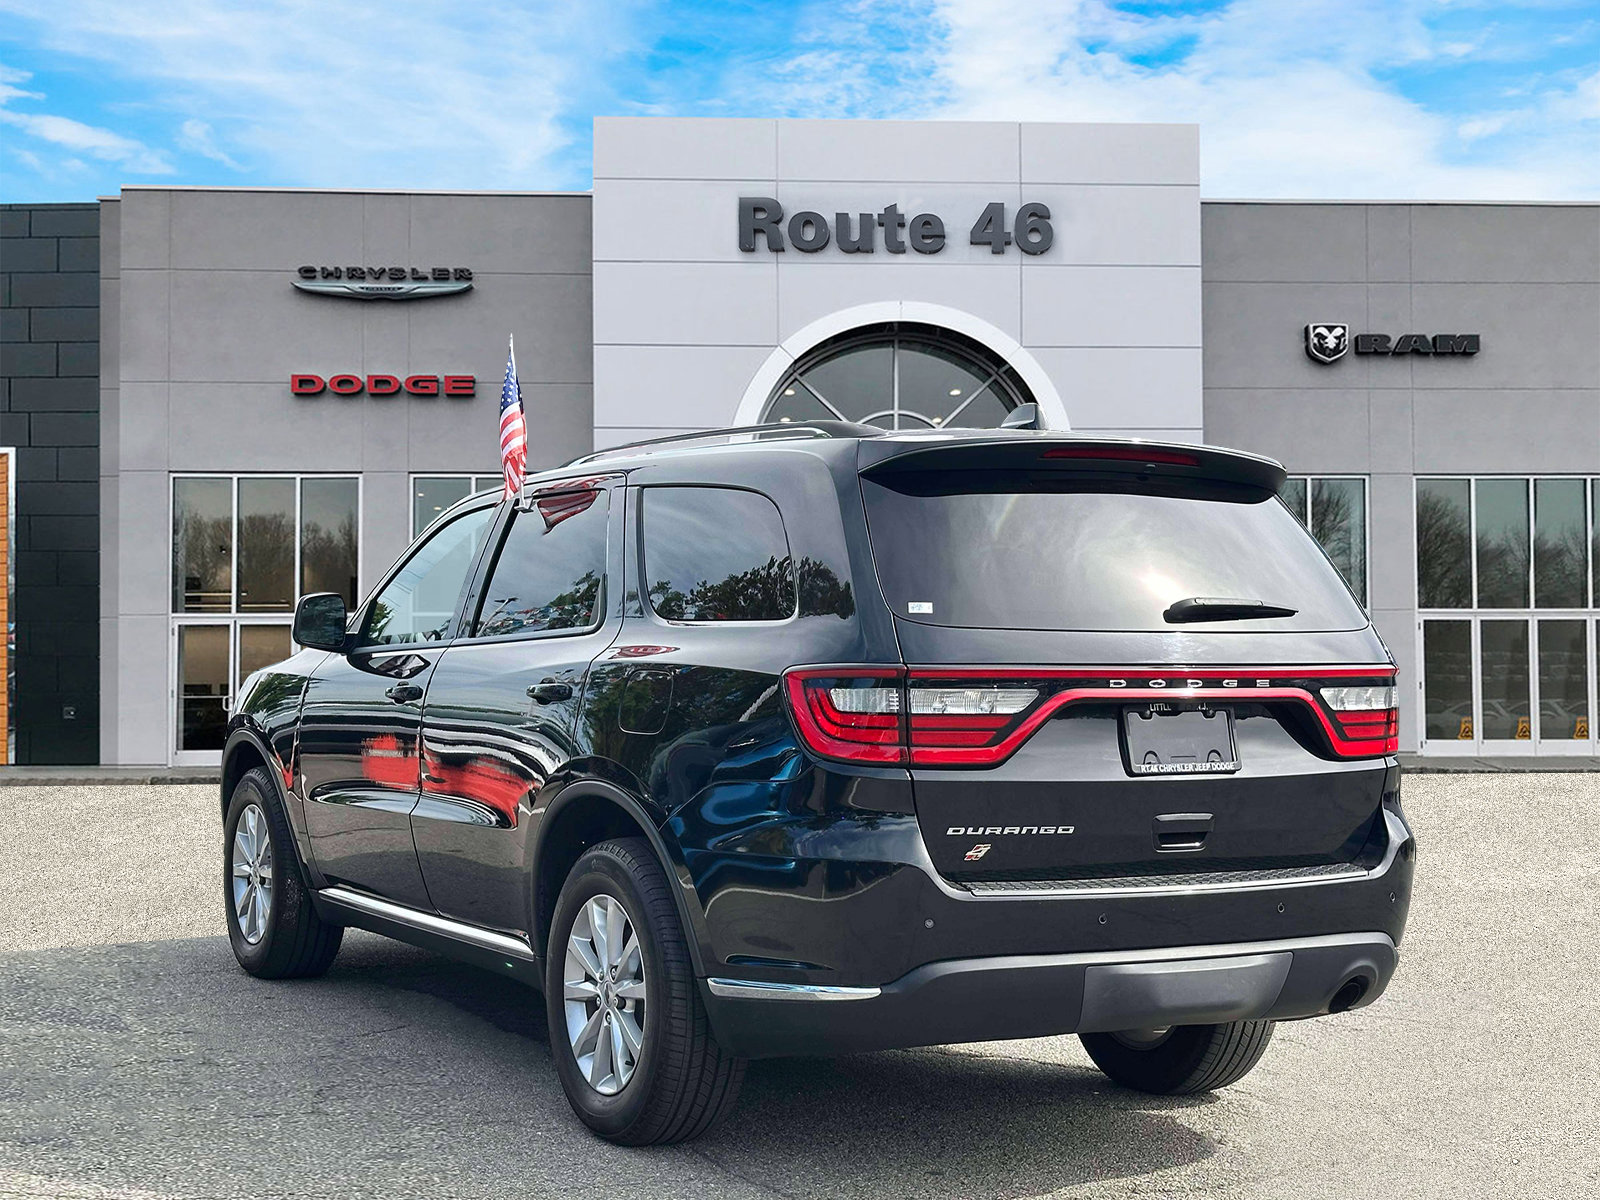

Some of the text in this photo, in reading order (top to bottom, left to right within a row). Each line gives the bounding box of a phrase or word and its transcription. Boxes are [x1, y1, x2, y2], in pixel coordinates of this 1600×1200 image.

[738, 196, 1054, 255] Route 46
[297, 265, 473, 281] CHRYSLER
[1354, 333, 1480, 356] RAM
[290, 373, 476, 397] DODGE
[1109, 679, 1270, 688] DODGE
[1159, 763, 1193, 773] CHRYSLER
[1194, 762, 1211, 771] JEEP
[1212, 761, 1235, 771] DODGE
[946, 826, 1075, 835] DURANGO
